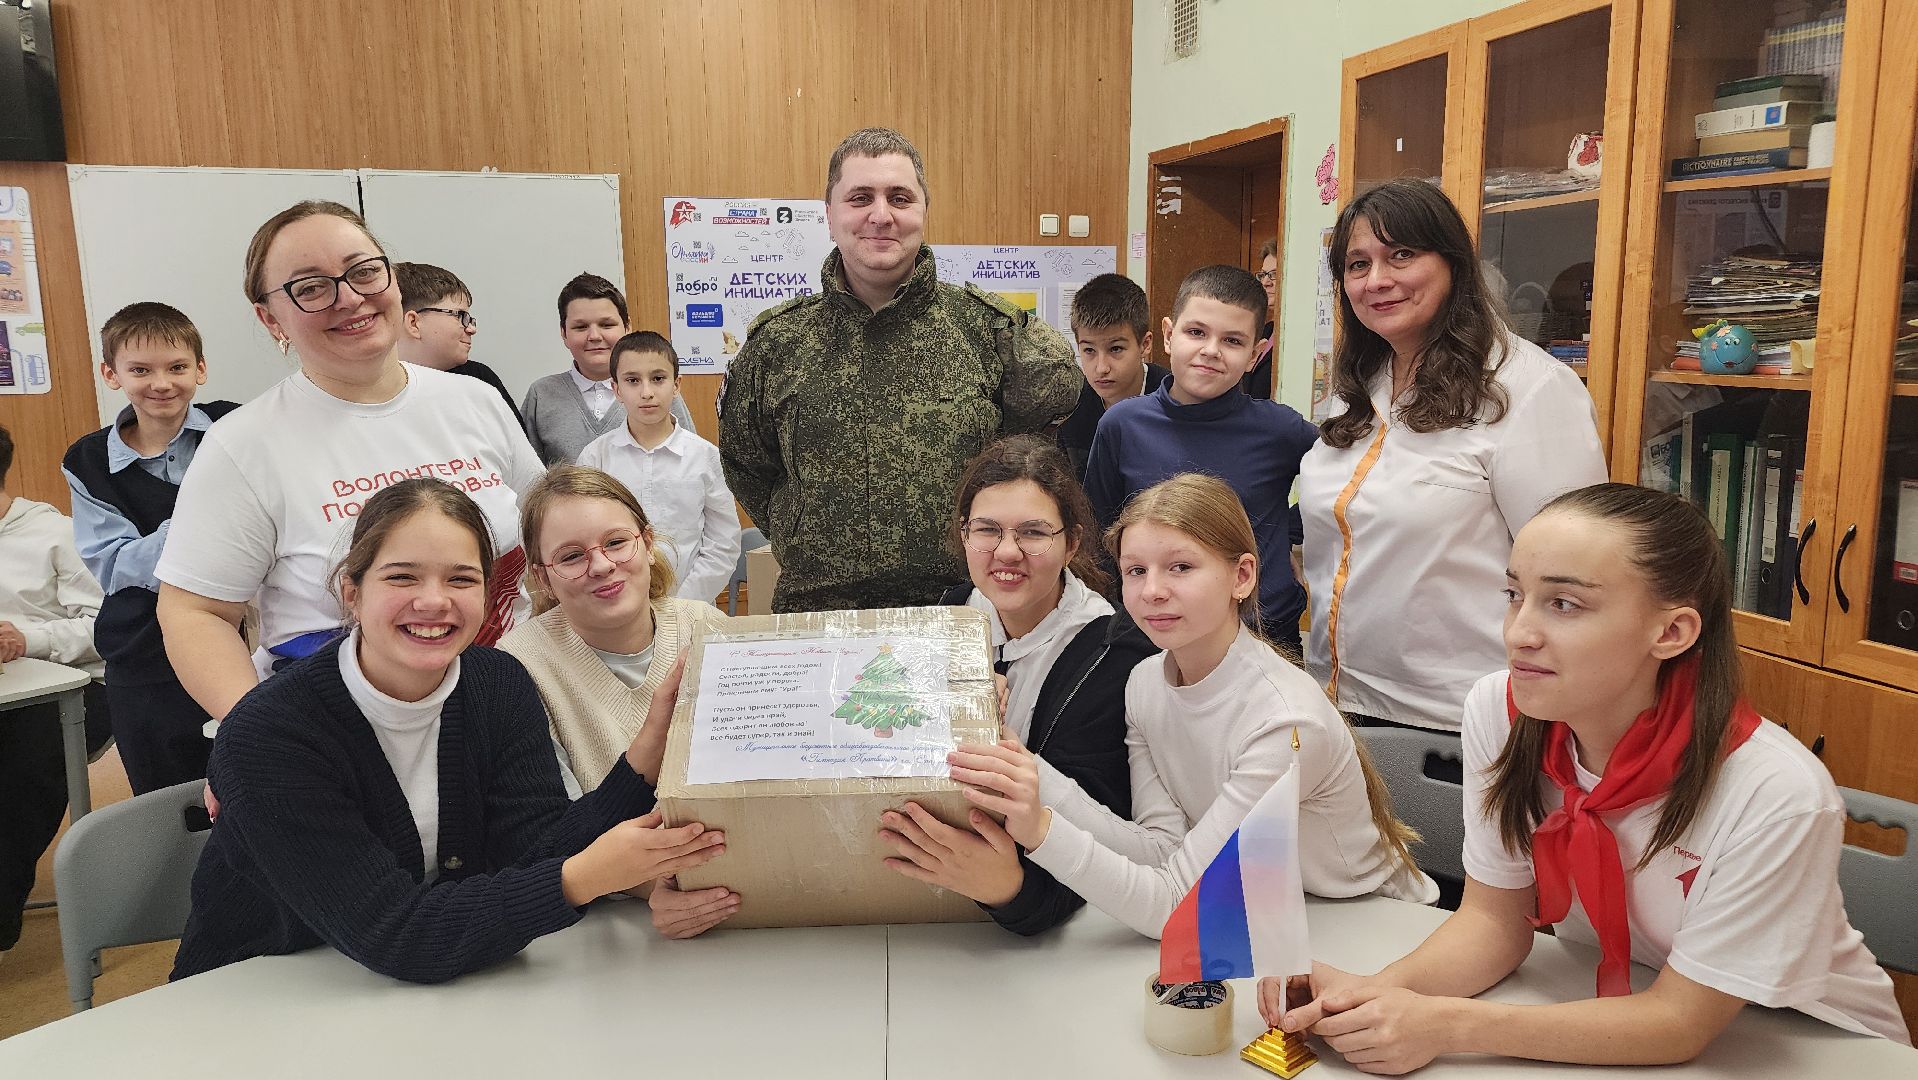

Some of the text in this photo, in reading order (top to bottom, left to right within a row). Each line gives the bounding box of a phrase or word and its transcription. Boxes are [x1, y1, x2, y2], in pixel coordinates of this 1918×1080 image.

[713, 217, 768, 225] ВОЗМОЖНОСТЕЙ
[750, 255, 784, 263] ЦЕНТР
[976, 260, 1036, 270] ДЕТСКИХ
[729, 272, 808, 286] ДЕТСКИХ
[972, 270, 1040, 280] ИНИЦИАТИВ
[676, 280, 718, 293] добро
[724, 287, 813, 299] ИНИЦИАТИВ
[332, 456, 483, 498] ВОЛОНТЕРЫ
